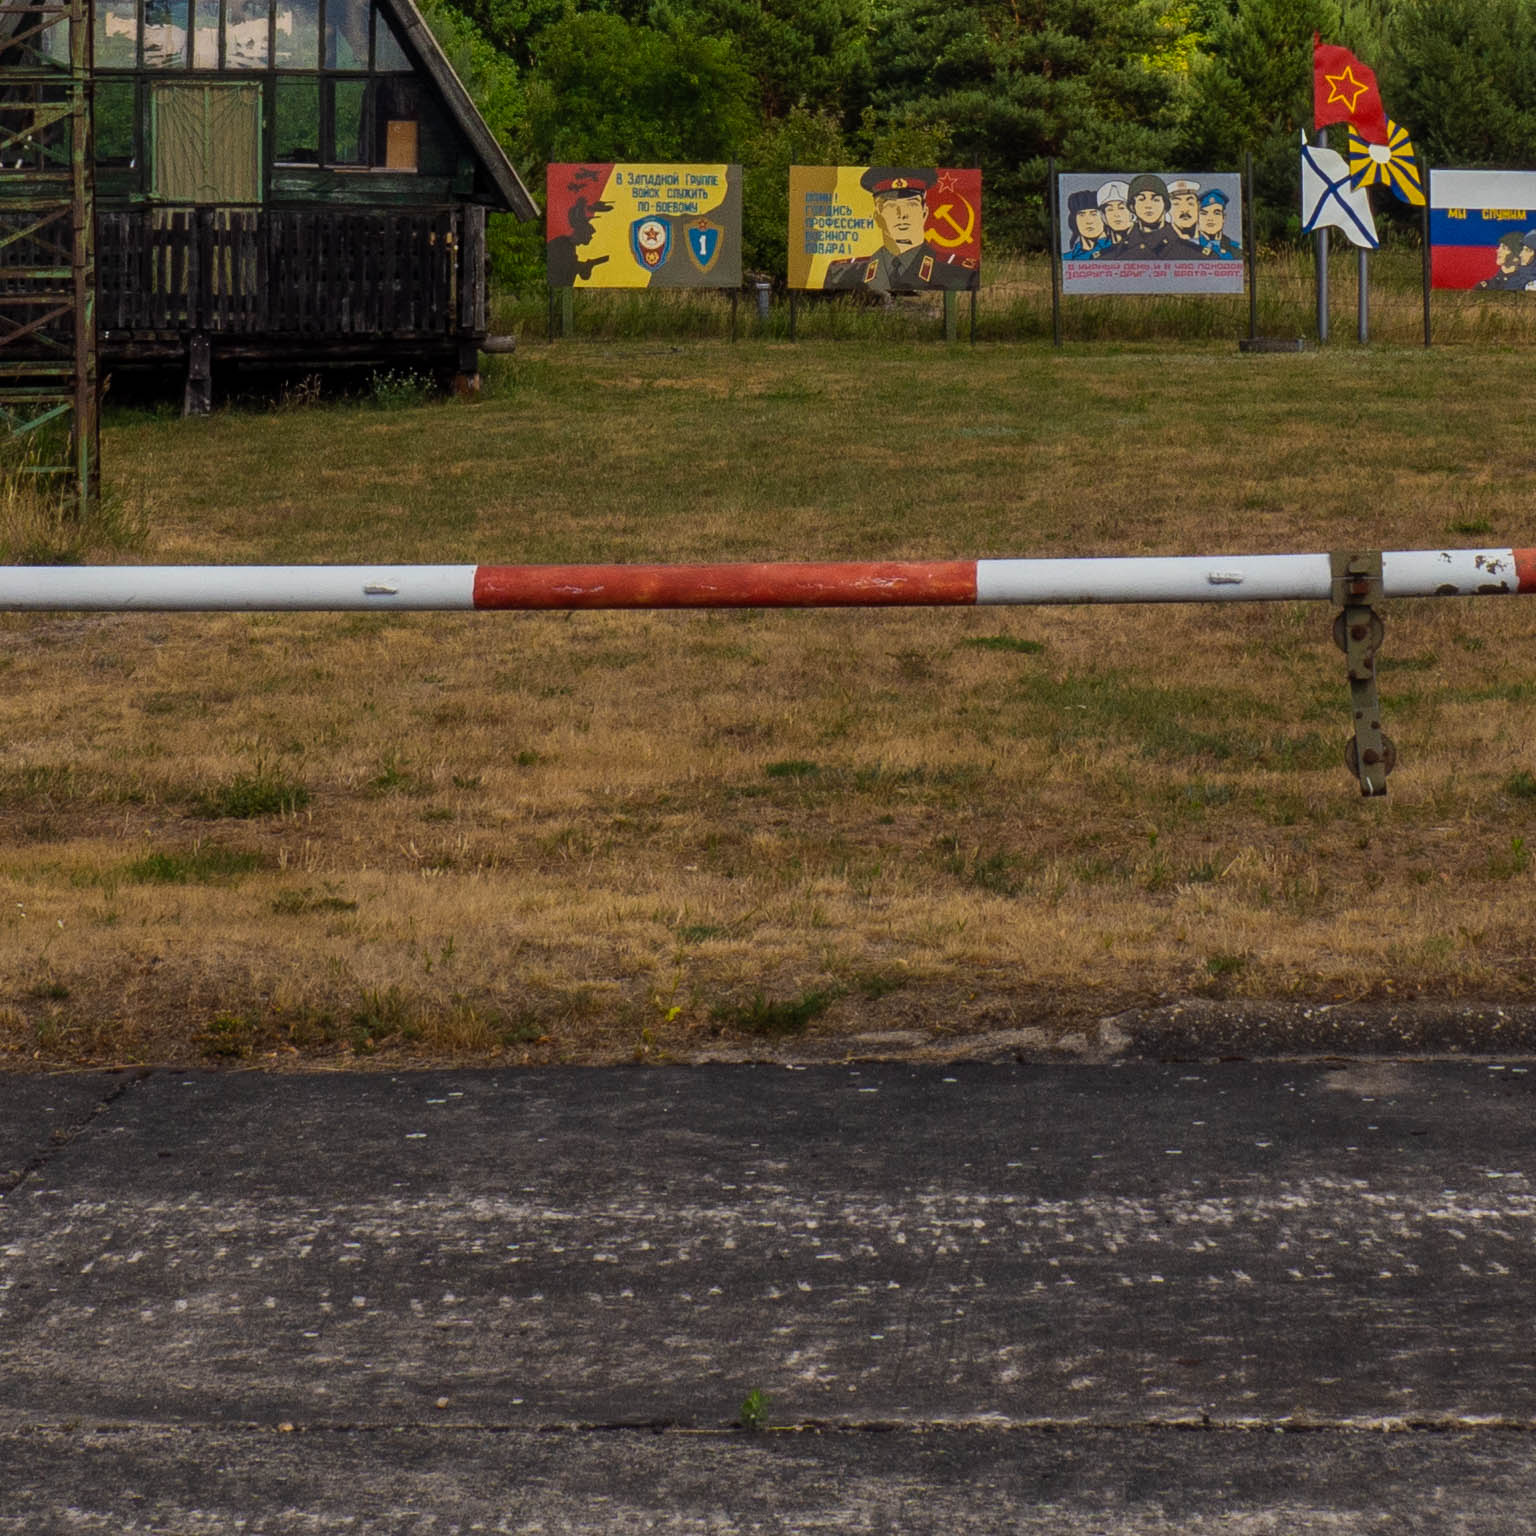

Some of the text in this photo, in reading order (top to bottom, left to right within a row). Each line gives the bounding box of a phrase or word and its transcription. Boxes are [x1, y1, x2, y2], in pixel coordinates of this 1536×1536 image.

[616, 173, 623, 185] В
[685, 173, 719, 185] ГРУППЕ
[666, 188, 708, 200] СЛУЖИТЬ
[1448, 207, 1467, 219] МЫ
[1482, 208, 1527, 221] СЛУЖИМ
[805, 215, 874, 229] ПРОФЕССИЕЙ
[805, 231, 859, 241] ВОЕННОГО
[699, 235, 707, 255] 1
